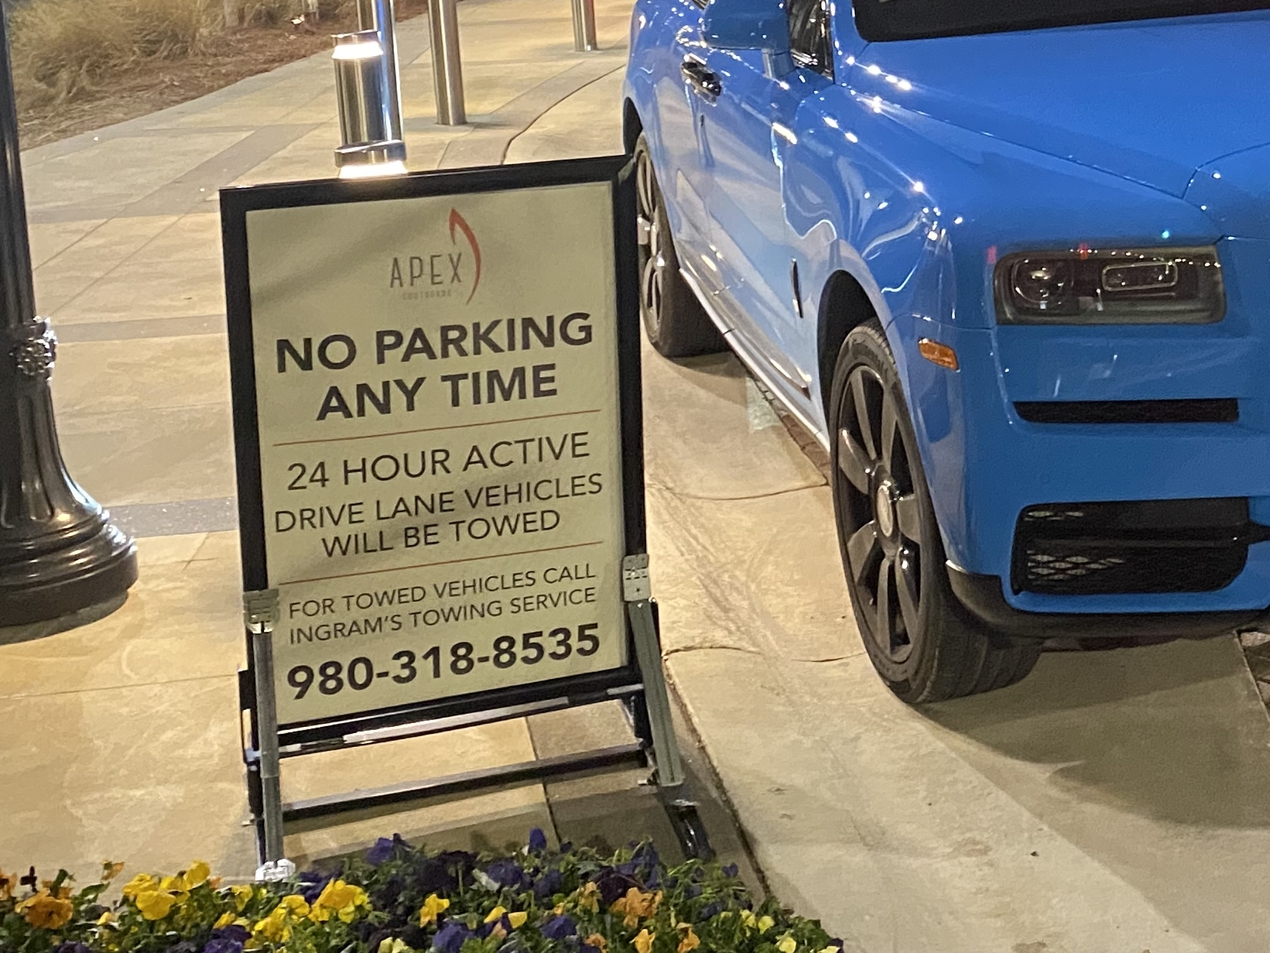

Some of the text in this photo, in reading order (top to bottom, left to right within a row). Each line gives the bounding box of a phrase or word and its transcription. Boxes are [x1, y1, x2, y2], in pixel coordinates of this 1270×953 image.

[390, 252, 462, 288] APEX
[276, 312, 593, 373] NO PARKING
[316, 363, 557, 421] ANY TIME
[287, 431, 591, 490] 24 HOUR ACTIVE
[275, 472, 603, 533] DRIVE LANE VEHICLES
[322, 509, 561, 558] WILL BE TOWED
[289, 563, 597, 619] FOR TOWED VEHICLES CALL
[290, 586, 597, 645] INGRAM'S TOWING SERVICE
[287, 622, 601, 700] 980-318-8535
